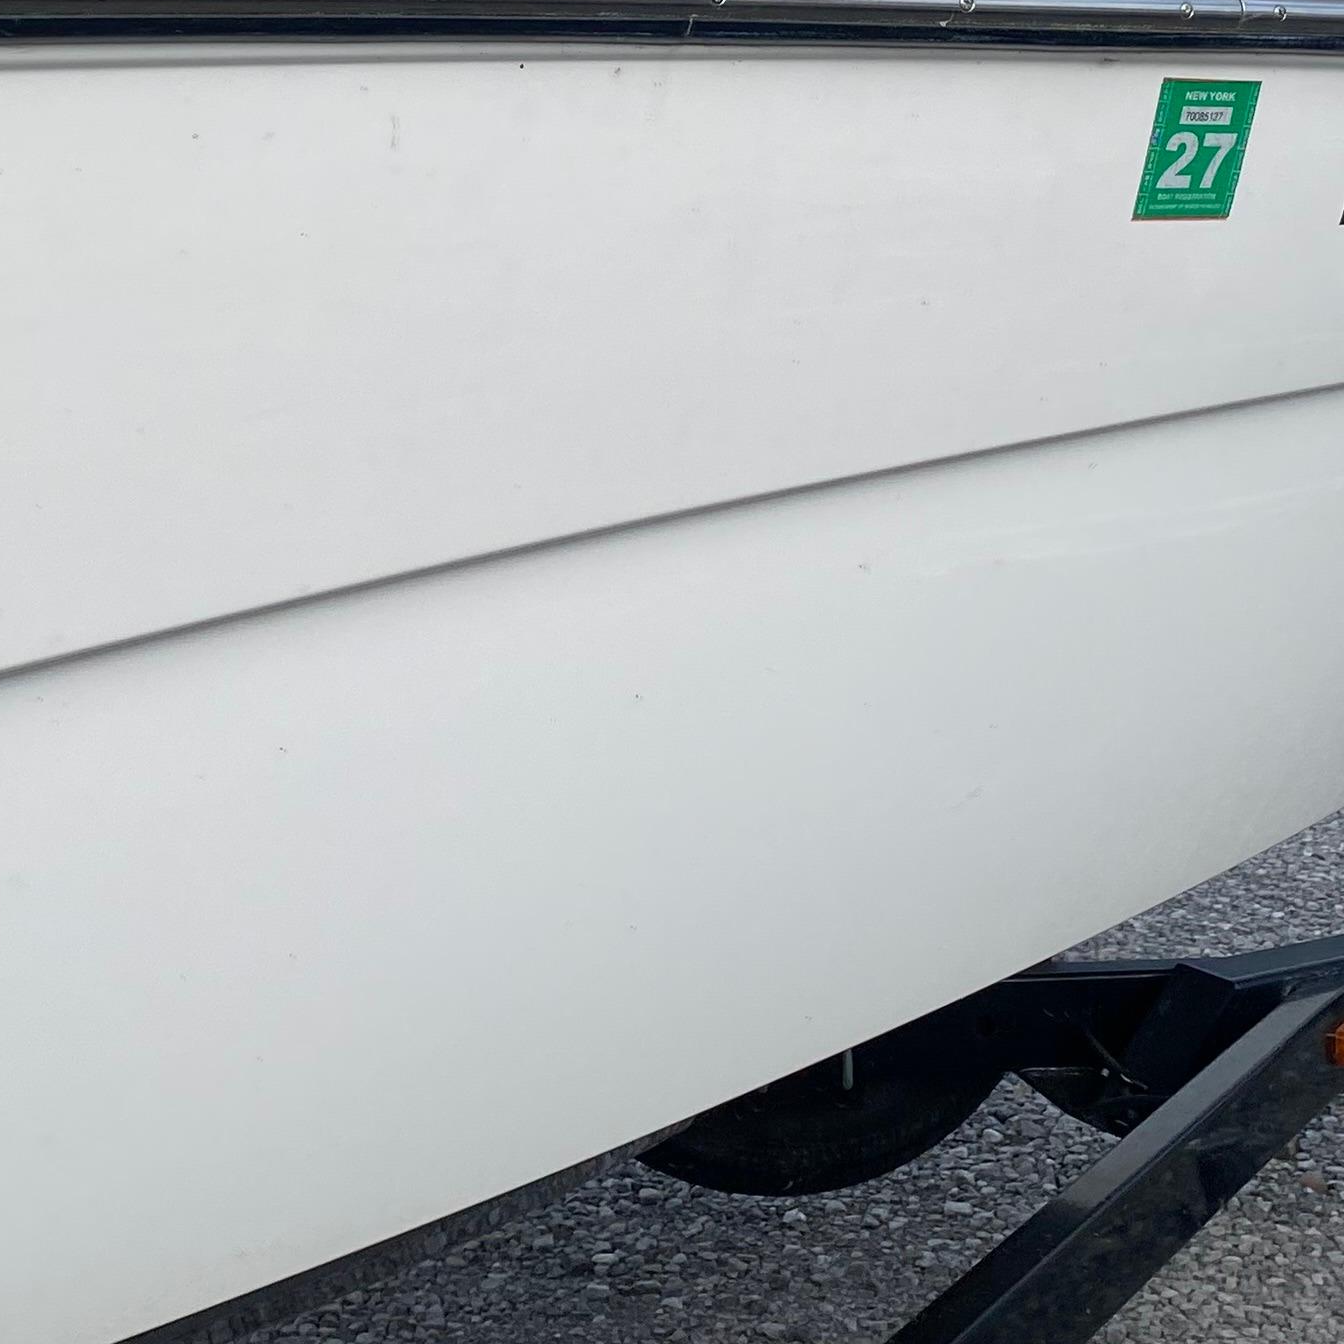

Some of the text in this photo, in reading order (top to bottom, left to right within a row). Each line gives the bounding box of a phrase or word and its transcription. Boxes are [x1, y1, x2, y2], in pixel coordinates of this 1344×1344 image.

[1185, 90, 1236, 101] NEW YORK
[1156, 131, 1239, 189] 27
